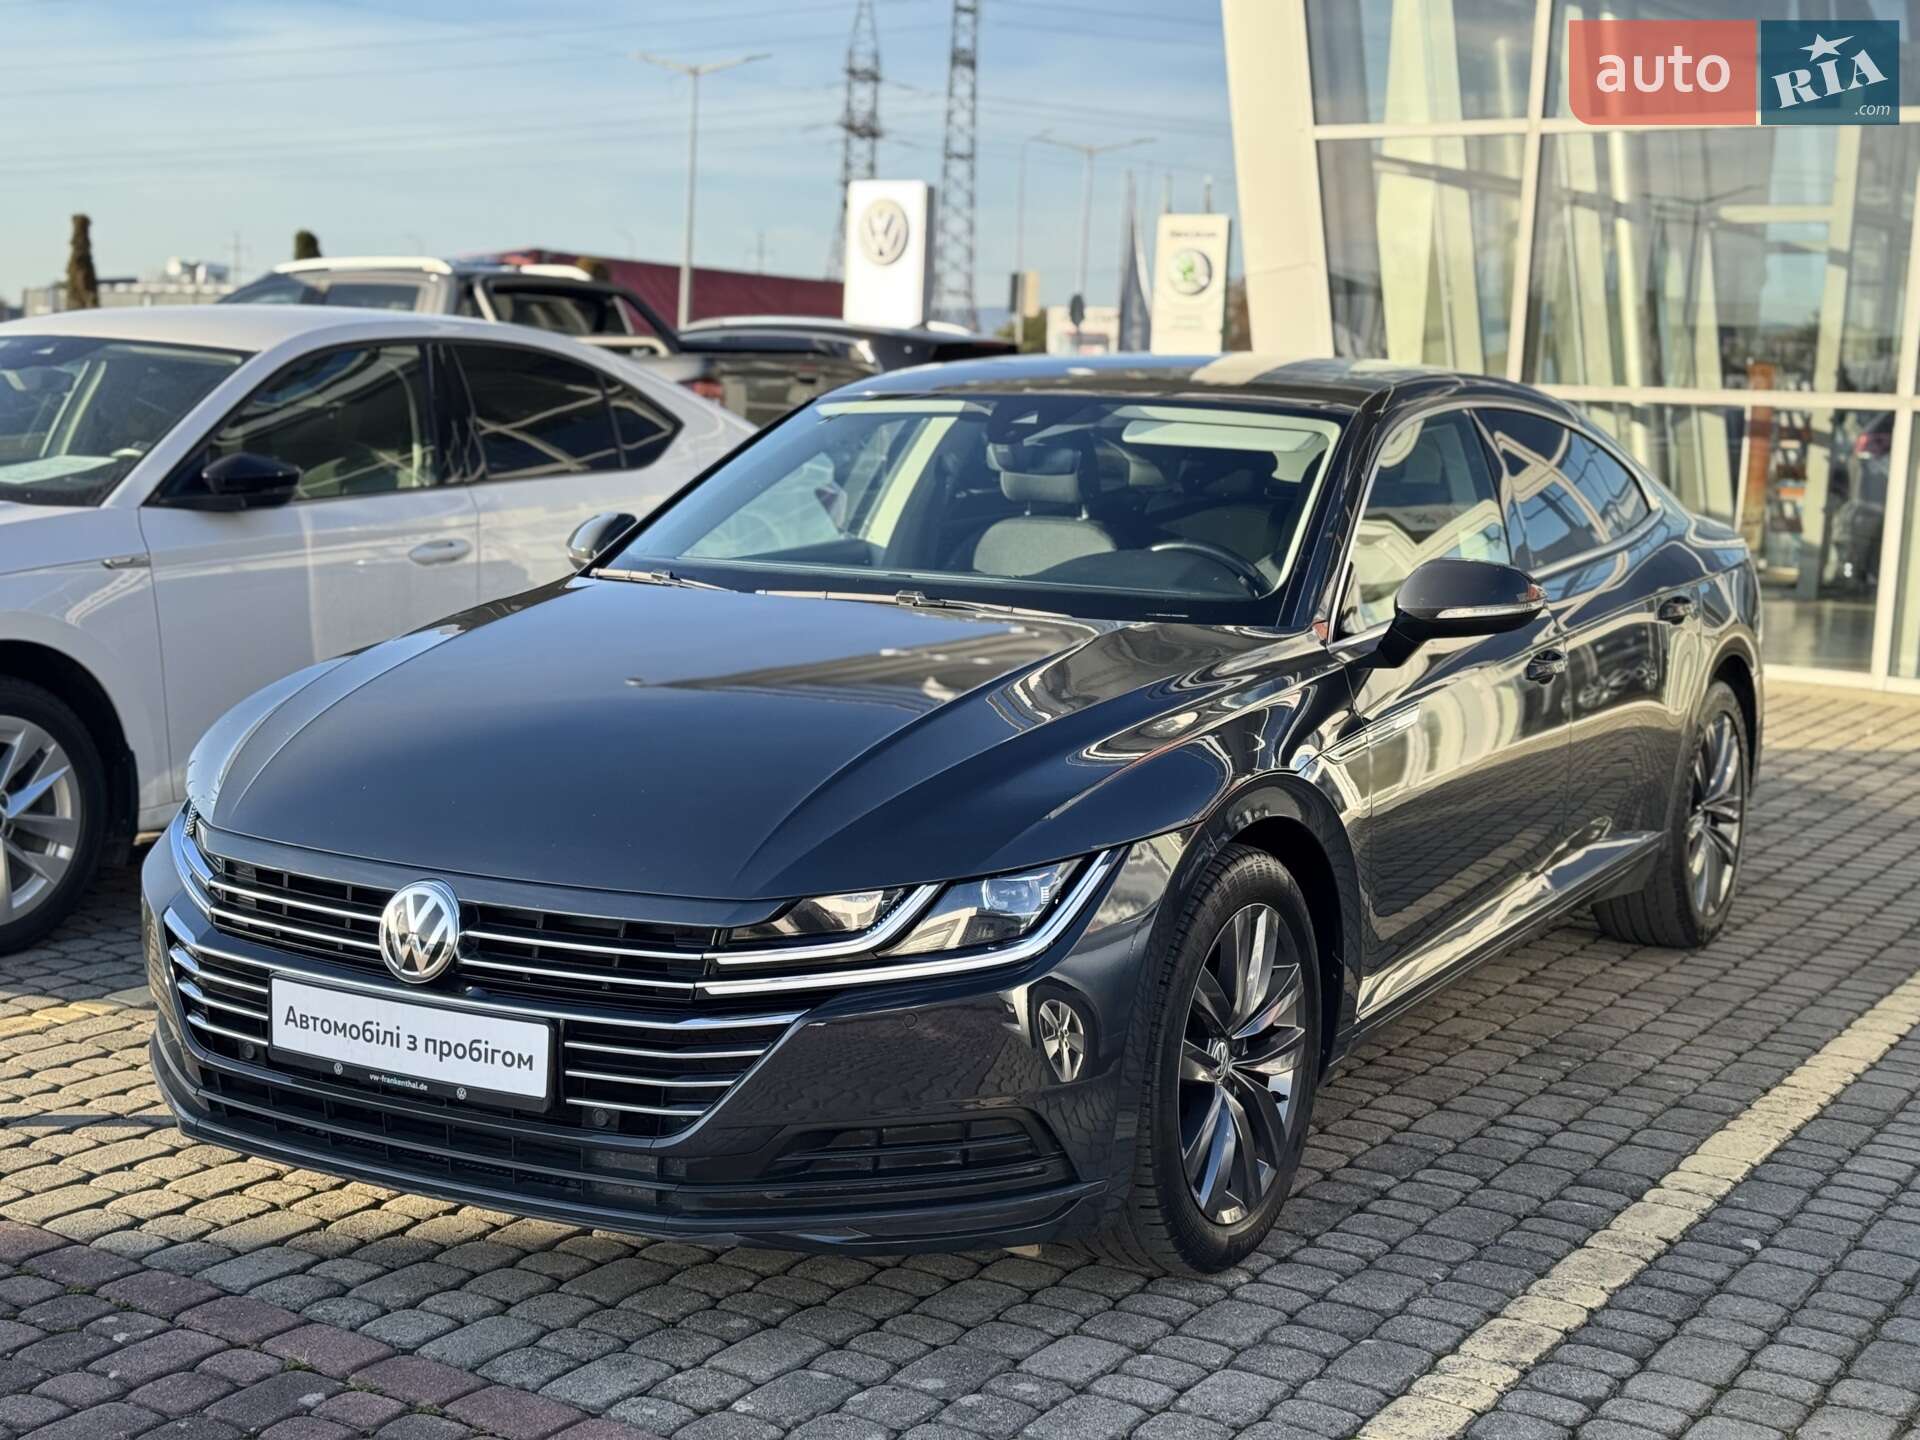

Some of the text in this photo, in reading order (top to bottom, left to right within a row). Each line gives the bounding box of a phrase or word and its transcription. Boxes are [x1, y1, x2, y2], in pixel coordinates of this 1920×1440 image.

[285, 1005, 534, 1071] Автомобілі з пробігом
[369, 1073, 428, 1091] vw-frankenthal.de
